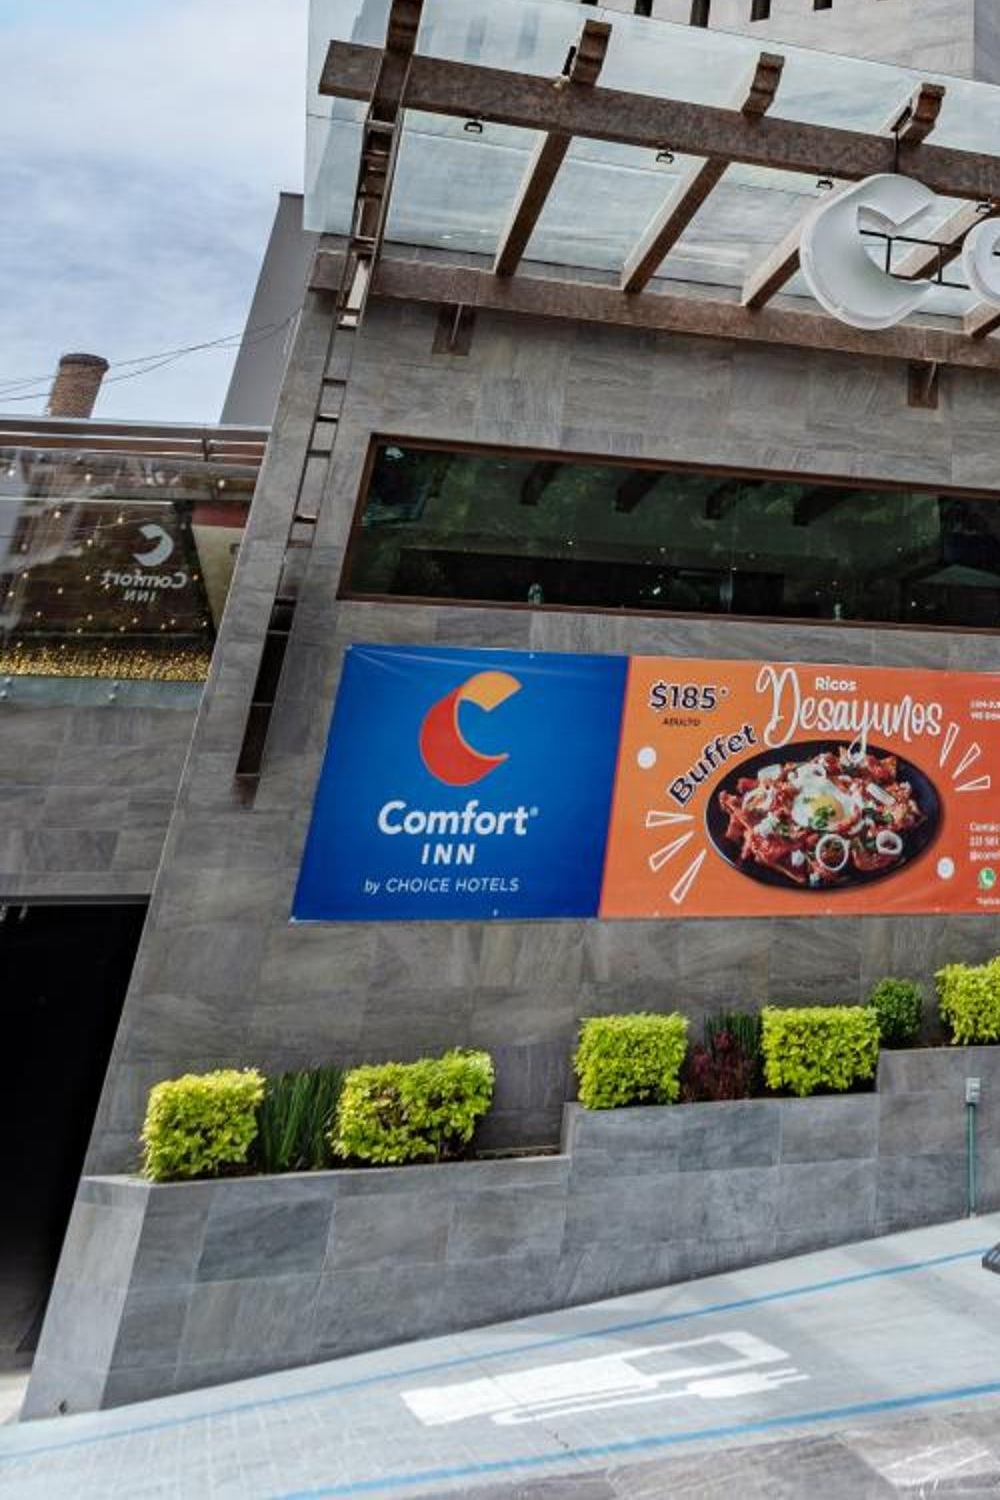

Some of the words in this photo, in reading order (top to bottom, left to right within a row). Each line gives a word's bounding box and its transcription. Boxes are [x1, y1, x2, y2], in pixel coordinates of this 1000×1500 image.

[815, 676, 857, 692] Ricos
[755, 665, 944, 767] Desayunos
[667, 723, 758, 808] Buffet
[421, 843, 476, 865] INN
[364, 880, 380, 896] by
[386, 877, 451, 893] CHOICE
[455, 877, 521, 893] HOTELS
